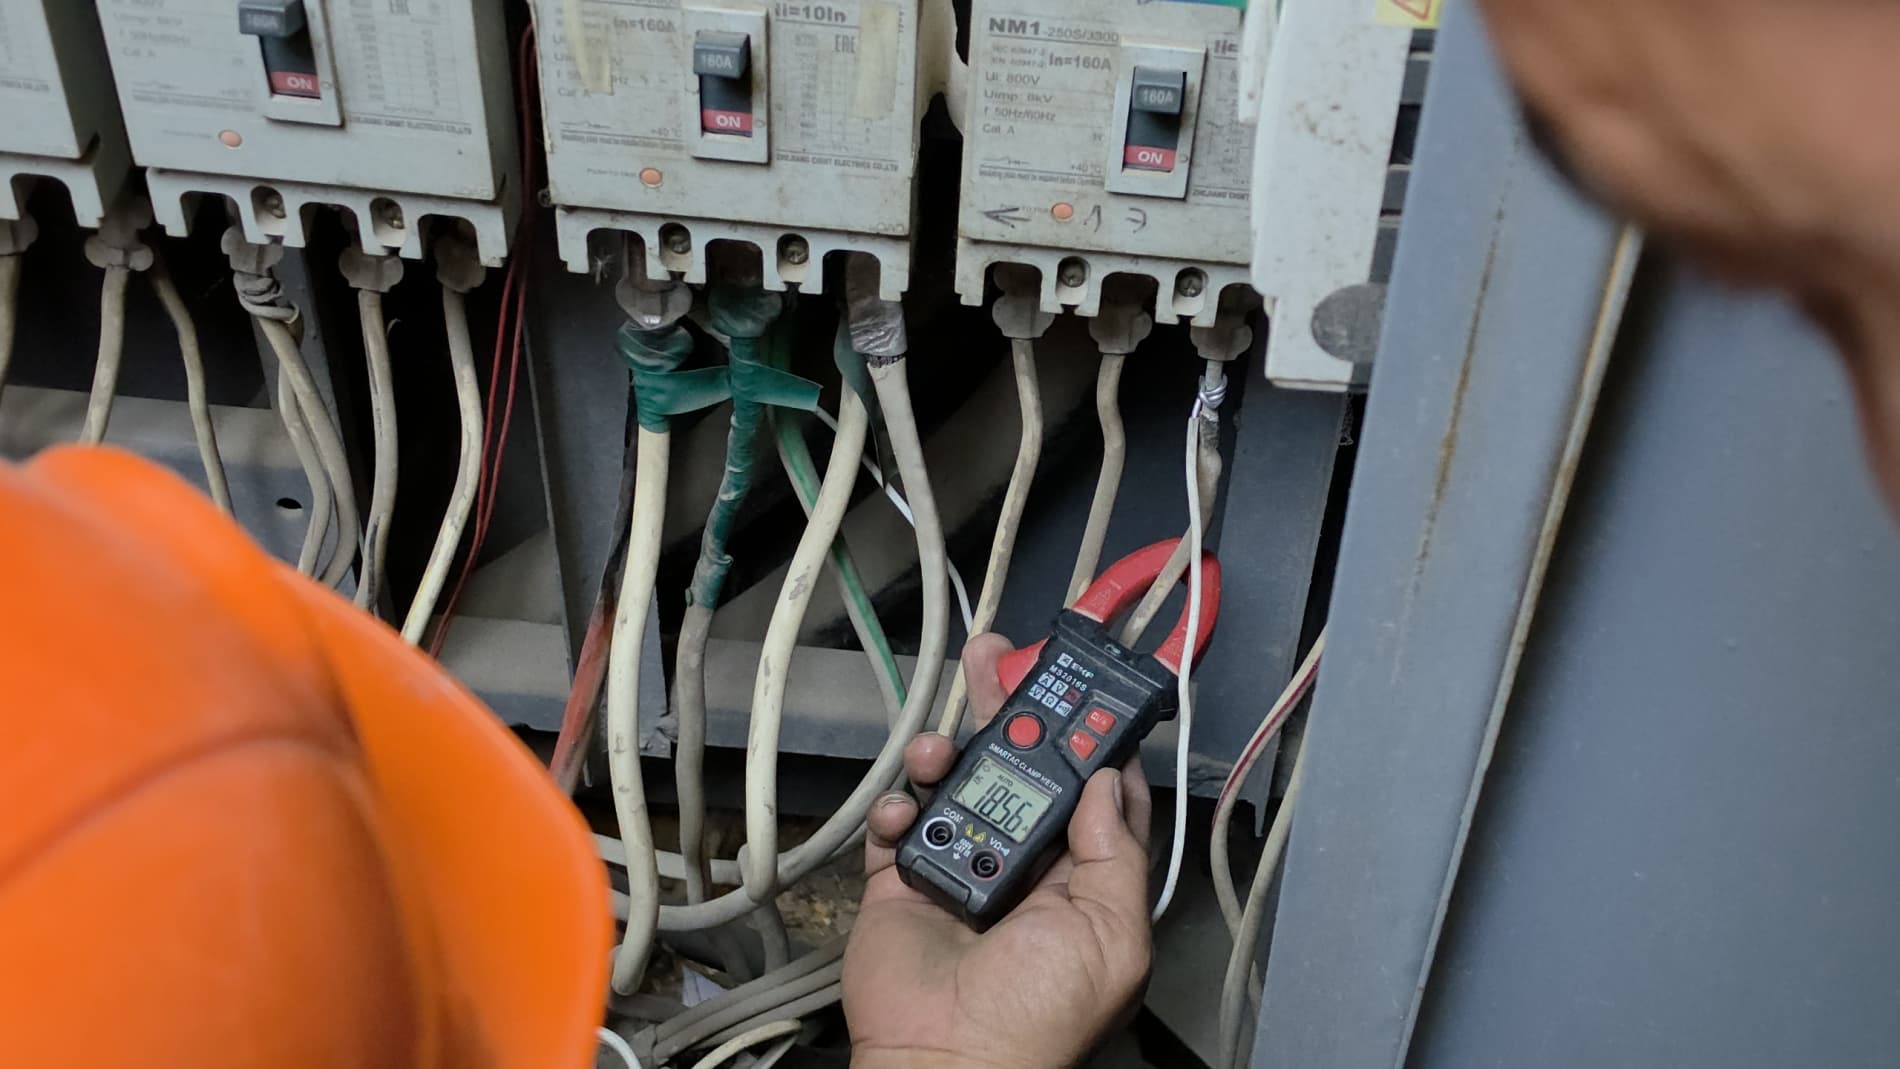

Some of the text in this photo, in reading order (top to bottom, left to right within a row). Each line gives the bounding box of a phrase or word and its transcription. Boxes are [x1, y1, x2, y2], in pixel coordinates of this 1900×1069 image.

[613, 17, 677, 32] In=160A
[989, 17, 1040, 35] NM1
[701, 53, 734, 69] 160A
[1049, 52, 1112, 71] In=160A
[286, 76, 313, 91] ON
[1006, 74, 1040, 85] 800V
[1142, 89, 1175, 104] 160A
[715, 114, 742, 129] ON
[1138, 151, 1164, 165] ON
[943, 807, 964, 824] COM
